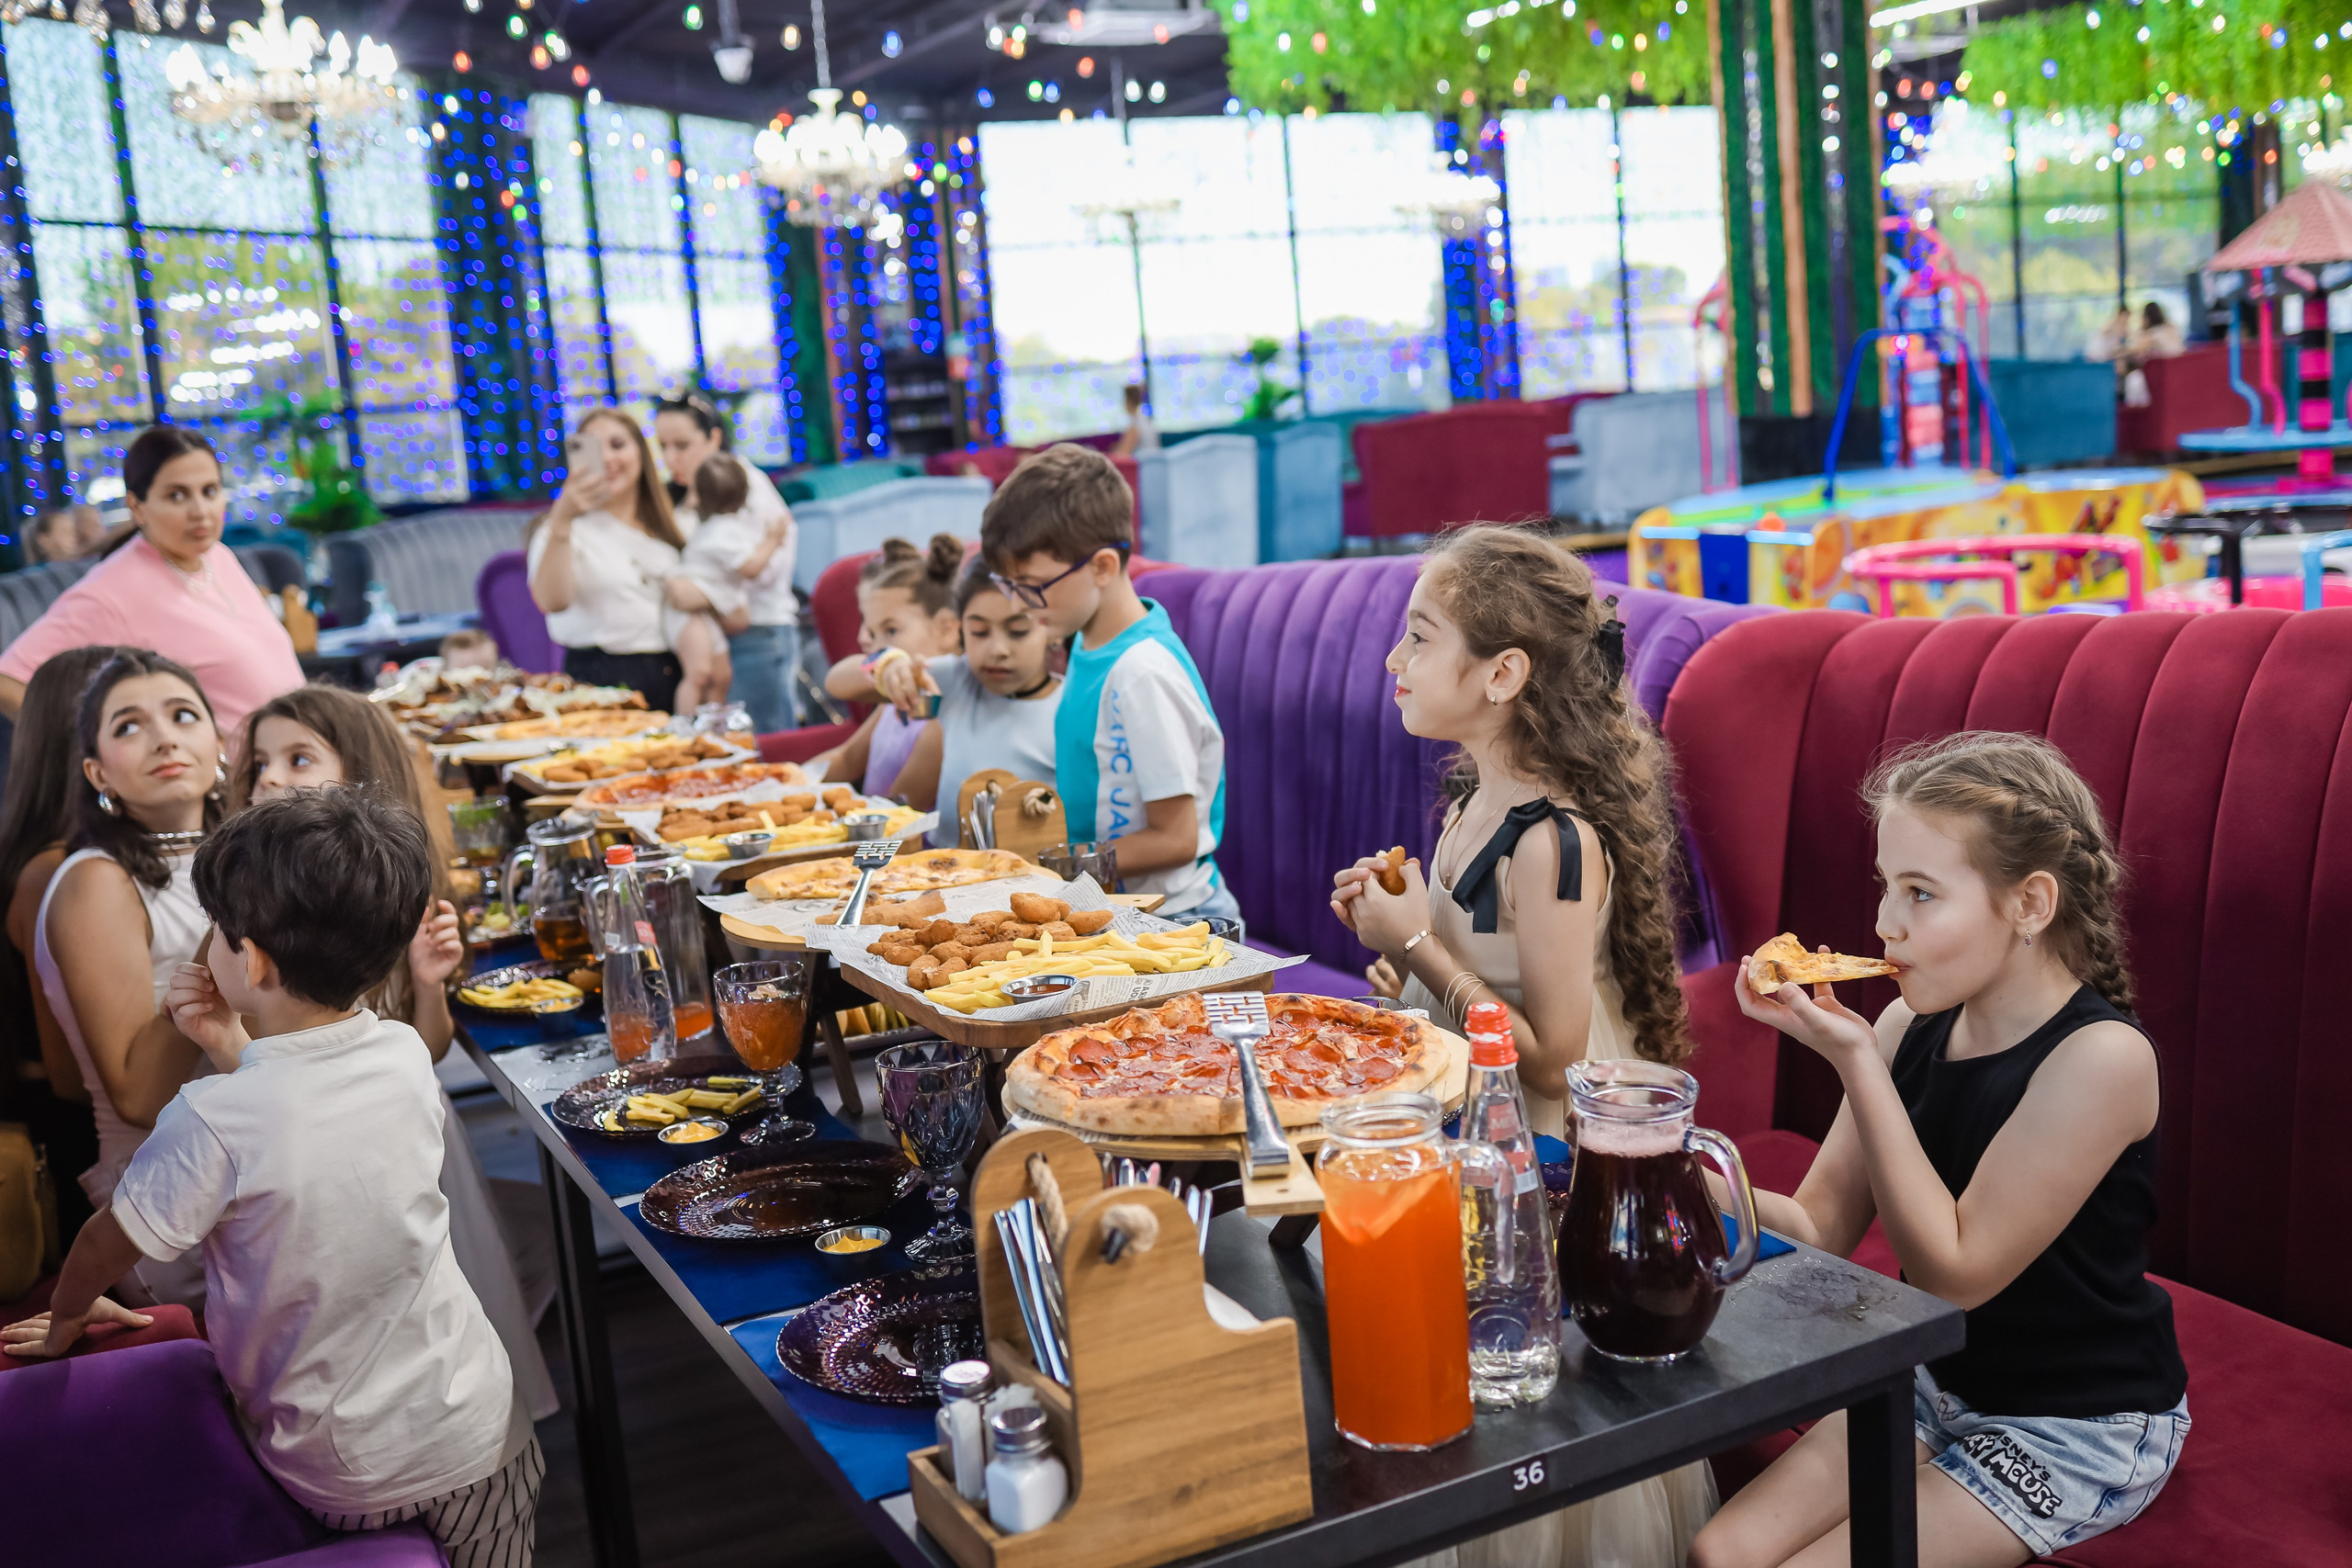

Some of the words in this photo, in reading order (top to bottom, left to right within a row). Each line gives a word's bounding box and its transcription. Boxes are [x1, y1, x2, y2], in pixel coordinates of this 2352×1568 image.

[1512, 1461, 1545, 1491] 36
[1997, 1435, 2052, 1482] SNEY'S
[1979, 1448, 2064, 1519] MOUSE
